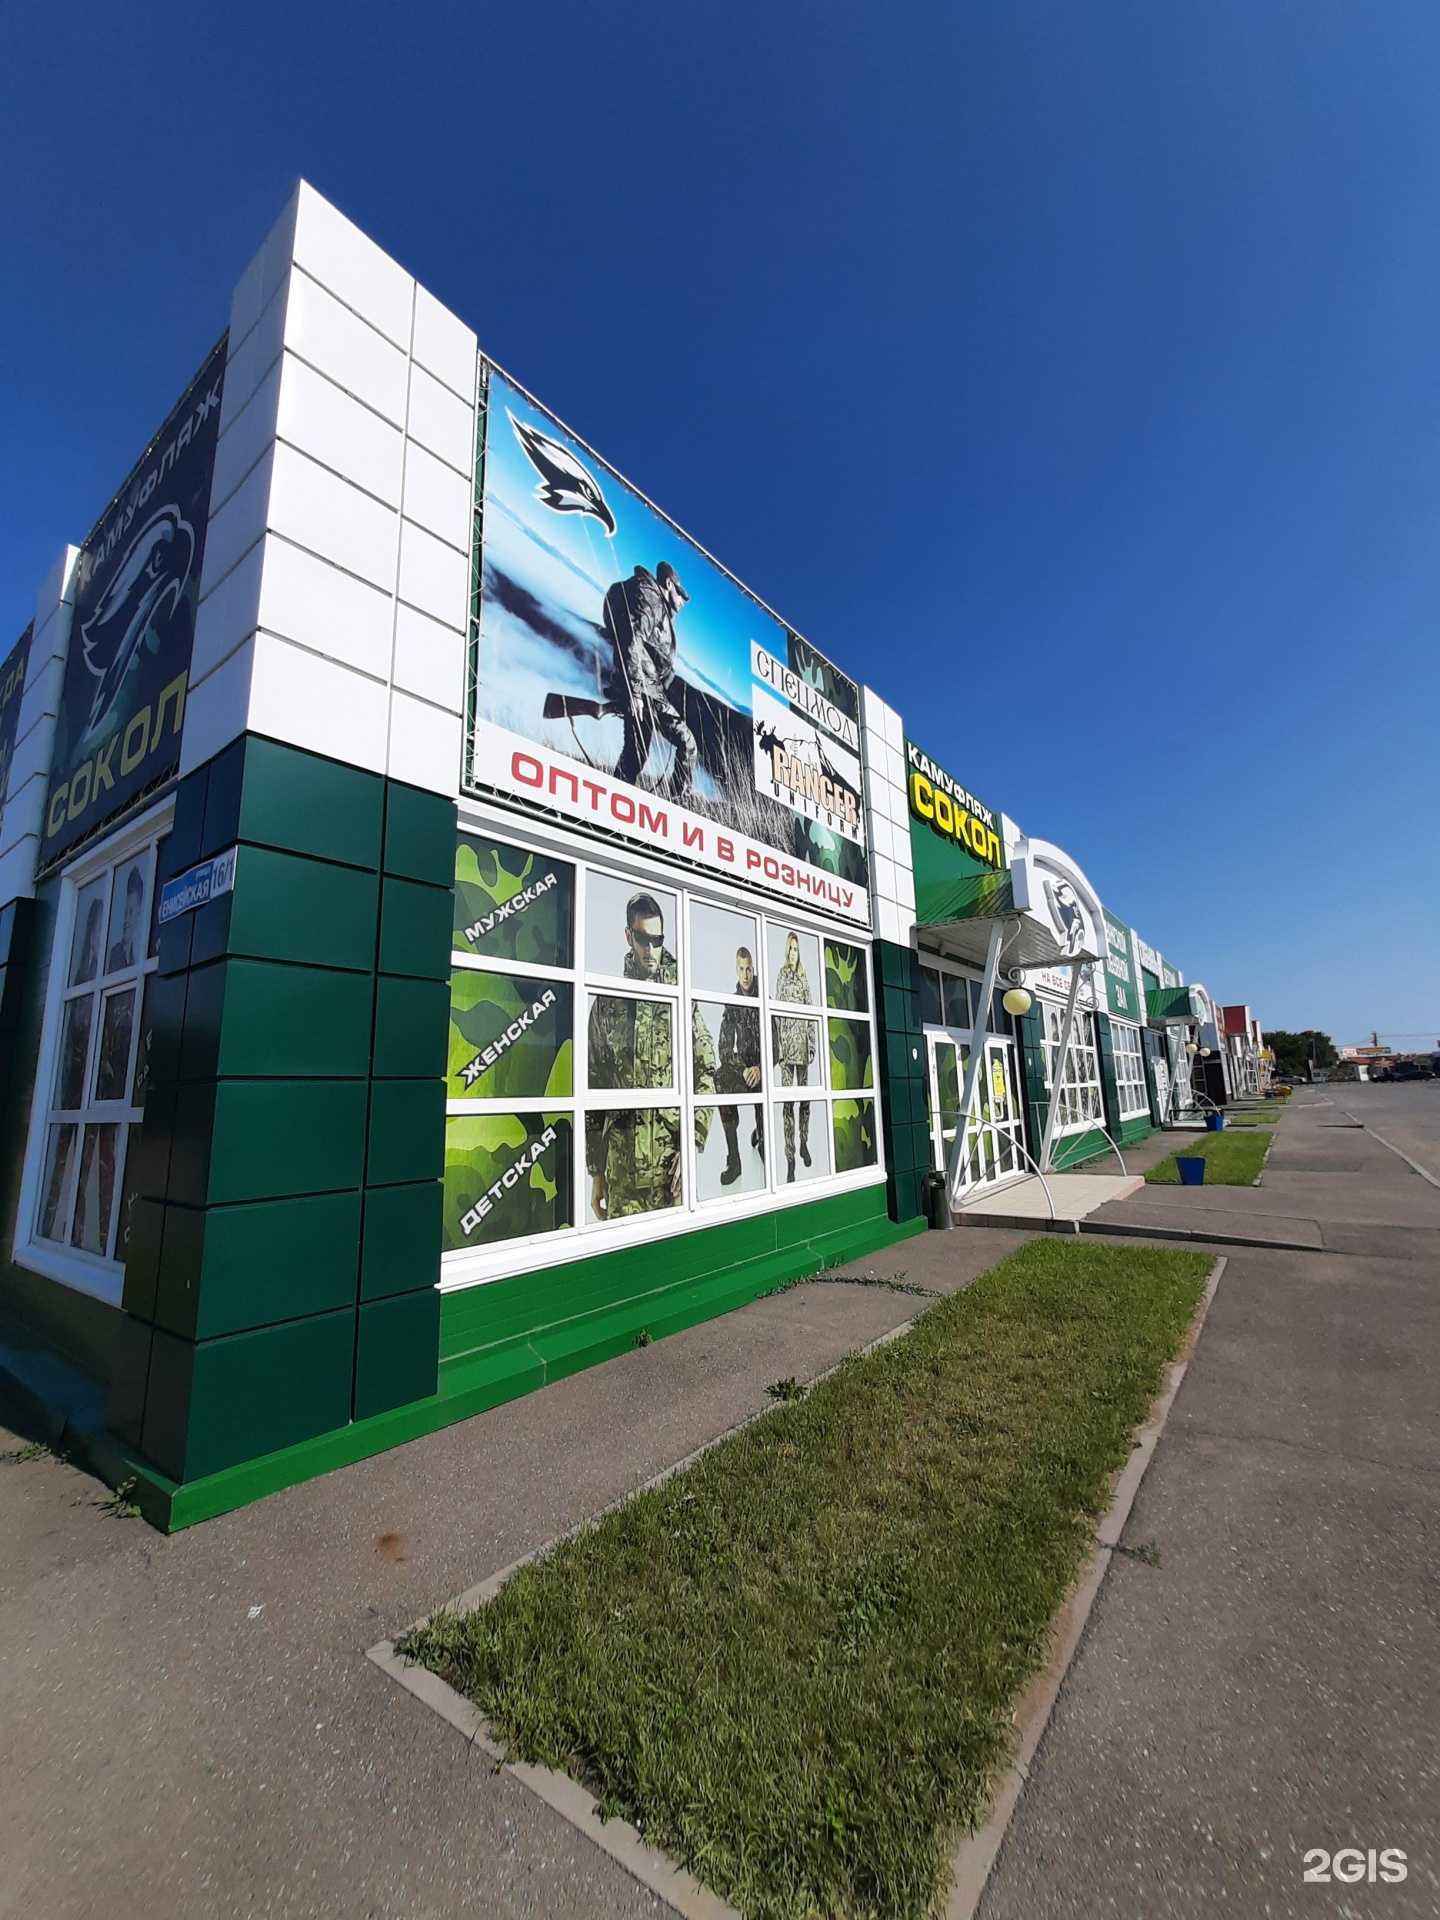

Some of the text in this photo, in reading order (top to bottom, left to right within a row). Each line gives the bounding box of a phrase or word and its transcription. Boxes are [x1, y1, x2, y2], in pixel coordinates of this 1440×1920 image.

[48, 670, 188, 838] СОКОЛ
[772, 744, 859, 825] RANGER
[907, 742, 994, 830] КАМУФЛЯЖ
[511, 752, 854, 909] ОПТОМ И В РОЗНИЦУ
[774, 783, 858, 840] UNIFORM
[910, 773, 1002, 869] СОКОЛ
[464, 873, 557, 942] МУЖСКАЯ
[460, 989, 557, 1086] ЖЕНСКАЯ
[460, 1127, 558, 1236] ДЕТСКАЯ
